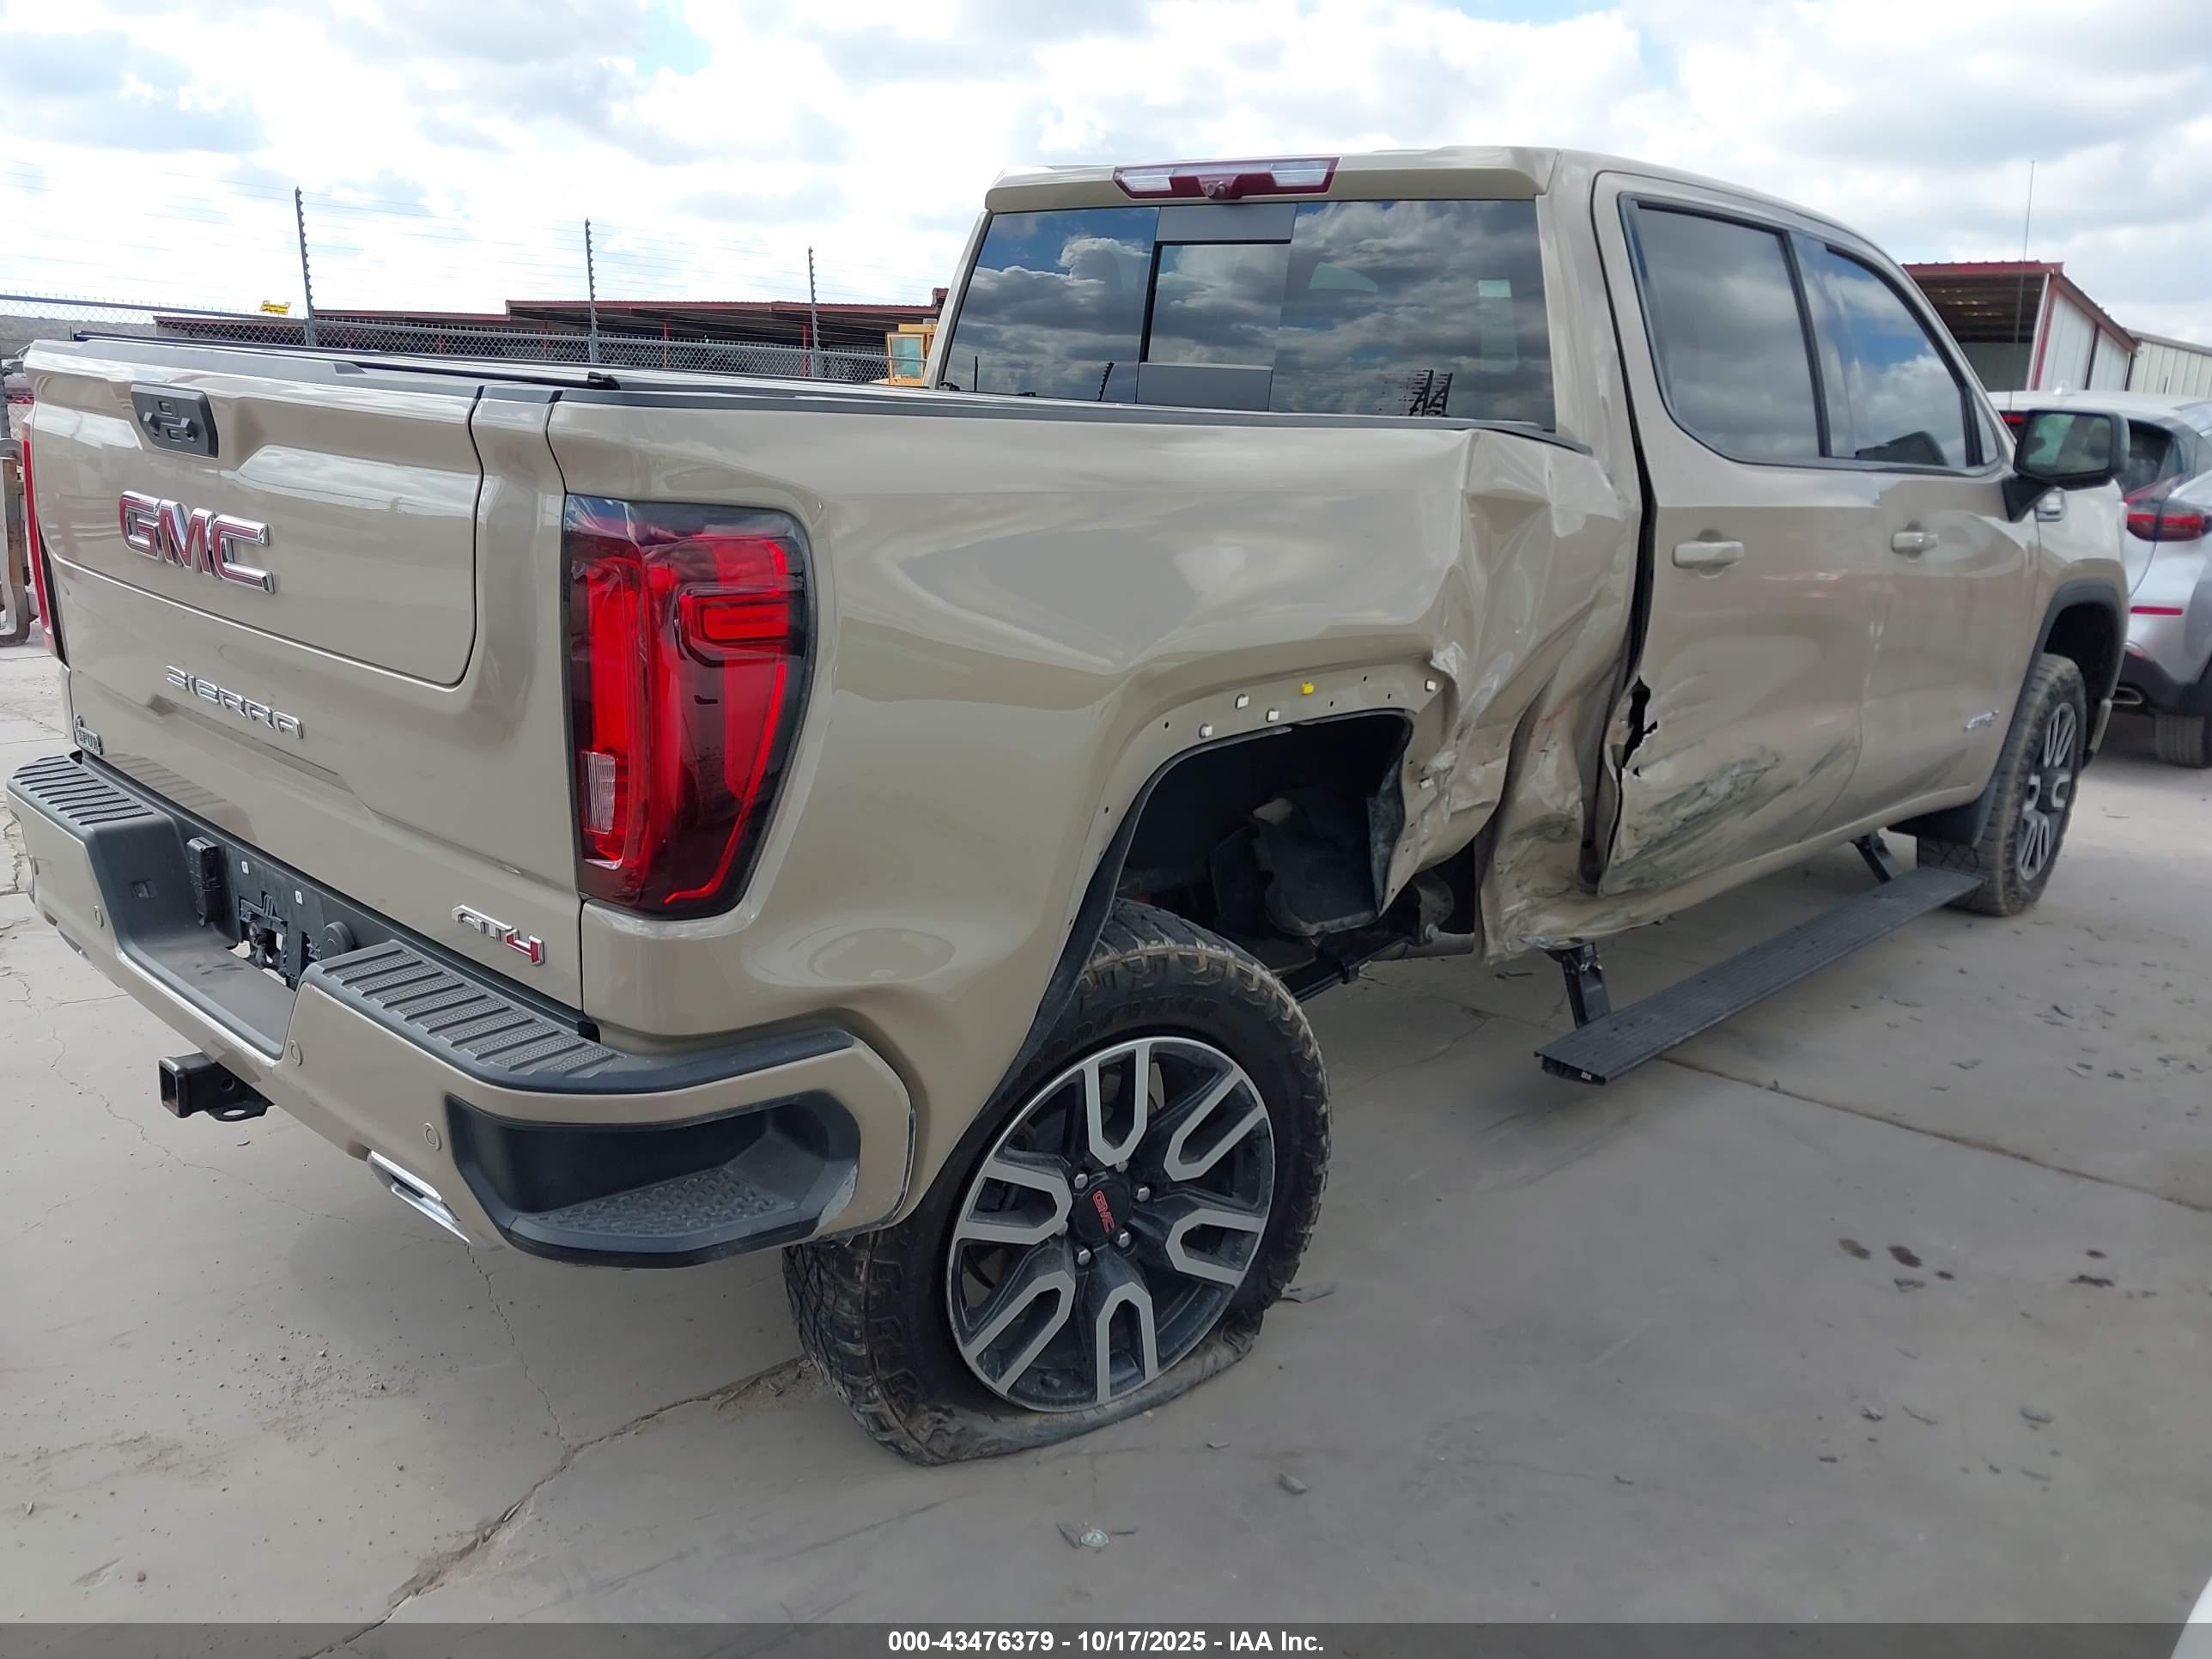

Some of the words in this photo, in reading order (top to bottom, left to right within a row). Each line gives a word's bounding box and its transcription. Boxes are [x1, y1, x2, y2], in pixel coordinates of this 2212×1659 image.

[119, 490, 275, 594] GMC
[166, 665, 304, 739] SIERRA
[452, 904, 545, 966] AT4
[1092, 1190, 1115, 1233] GMC
